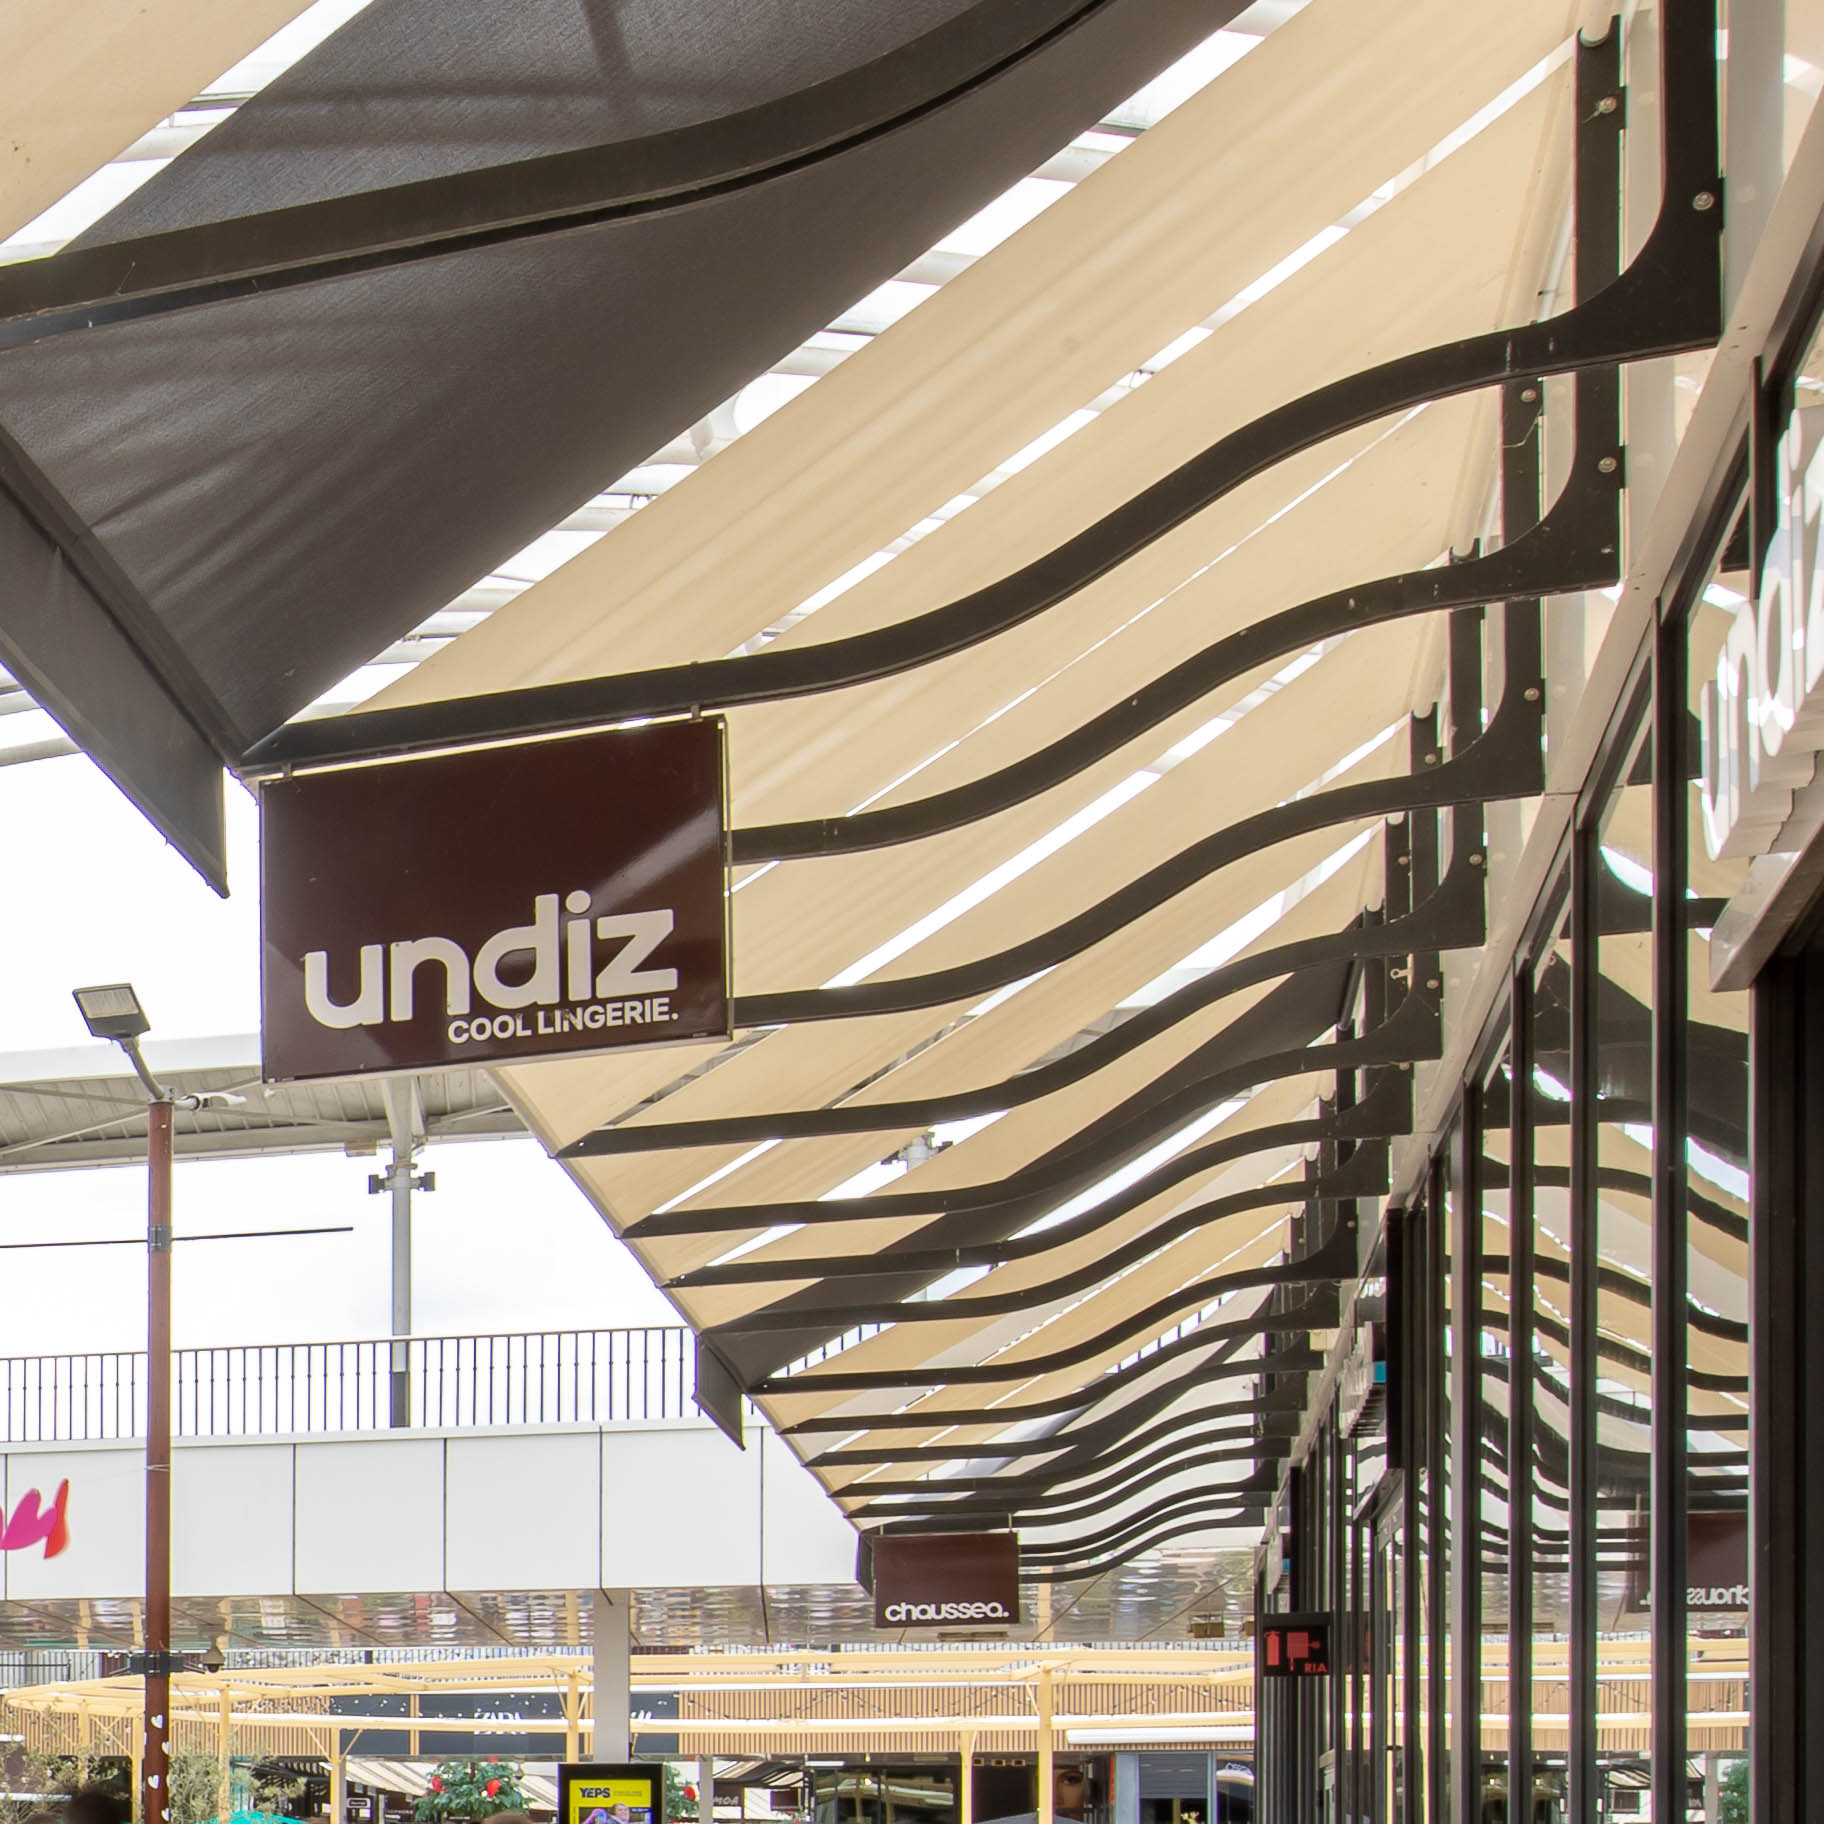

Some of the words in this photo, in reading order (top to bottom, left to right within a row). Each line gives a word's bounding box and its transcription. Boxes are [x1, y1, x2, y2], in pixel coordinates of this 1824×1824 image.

[304, 889, 679, 1029] undiz
[447, 1011, 533, 1044] COOL
[538, 996, 679, 1036] LINGERIE.
[1304, 1663, 1328, 1673] RIA
[579, 1787, 611, 1798] YEPS
